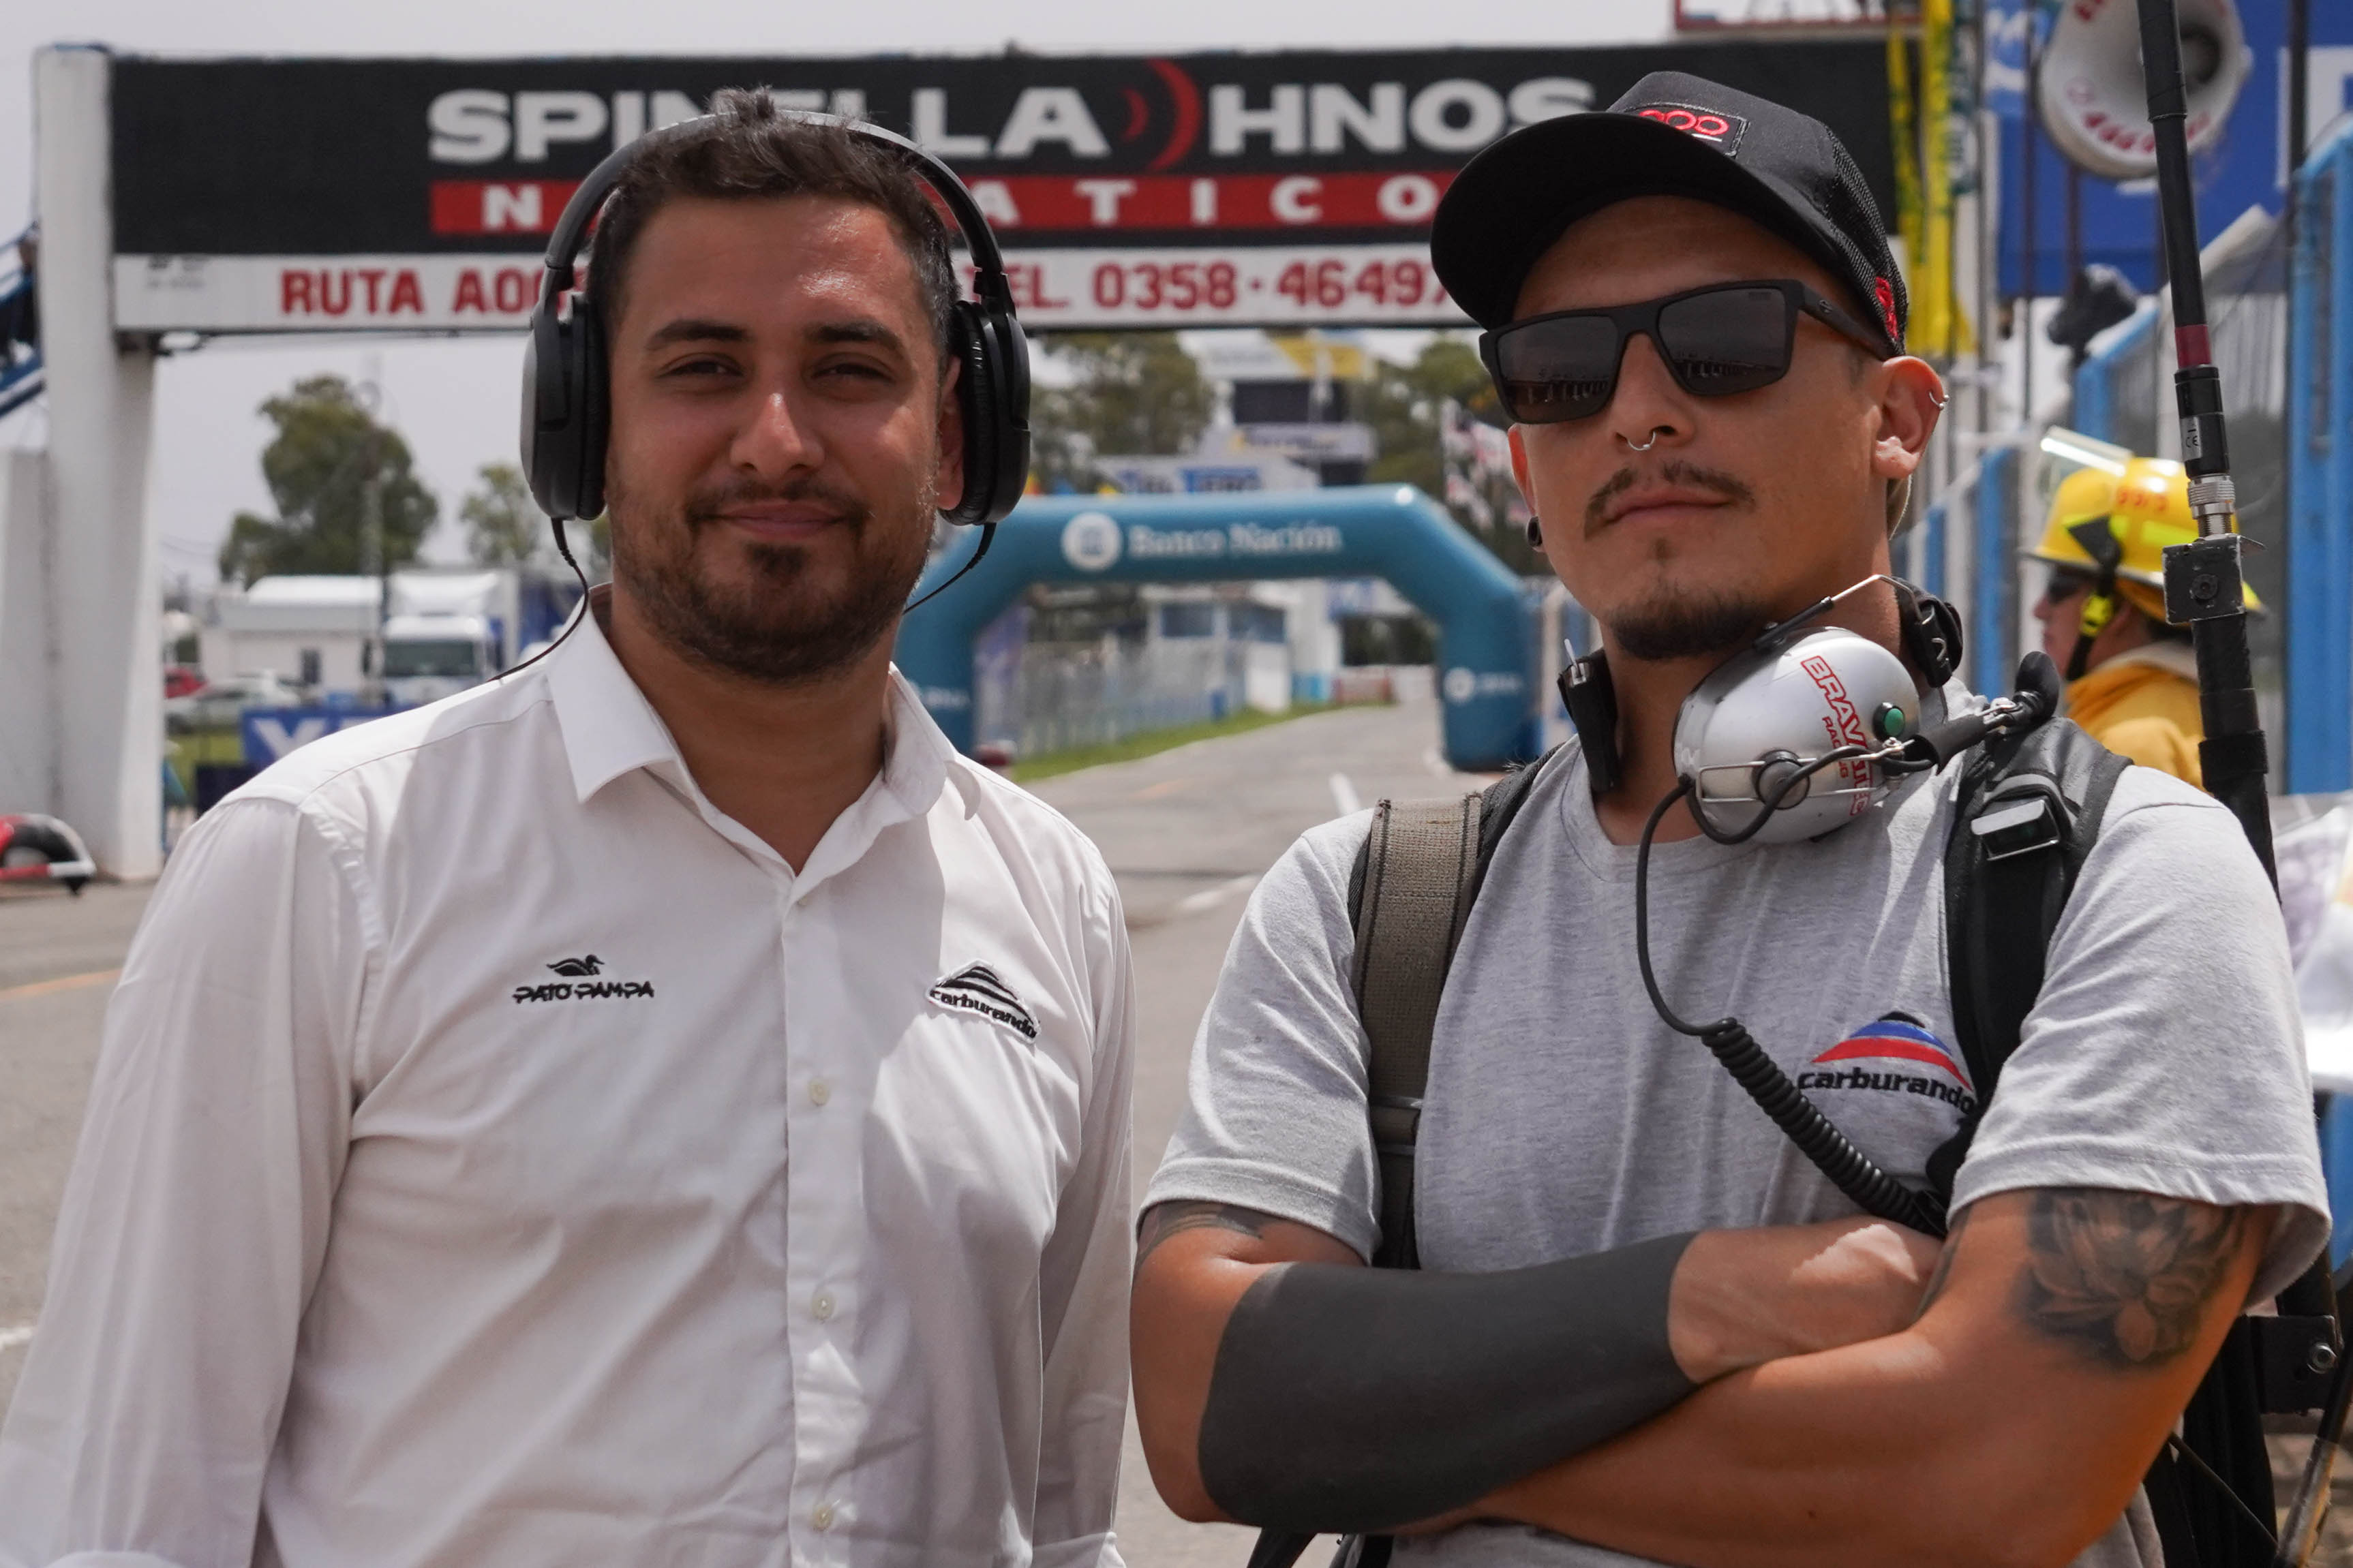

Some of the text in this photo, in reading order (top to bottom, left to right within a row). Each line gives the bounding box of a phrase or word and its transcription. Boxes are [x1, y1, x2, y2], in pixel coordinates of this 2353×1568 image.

[426, 87, 1112, 164] SPILA
[280, 266, 425, 317] RUTA
[1821, 716, 1849, 779] RACG
[513, 981, 654, 1004] PATO PAMPA
[929, 989, 1037, 1039] carburando
[1797, 1066, 1978, 1115] carburando
